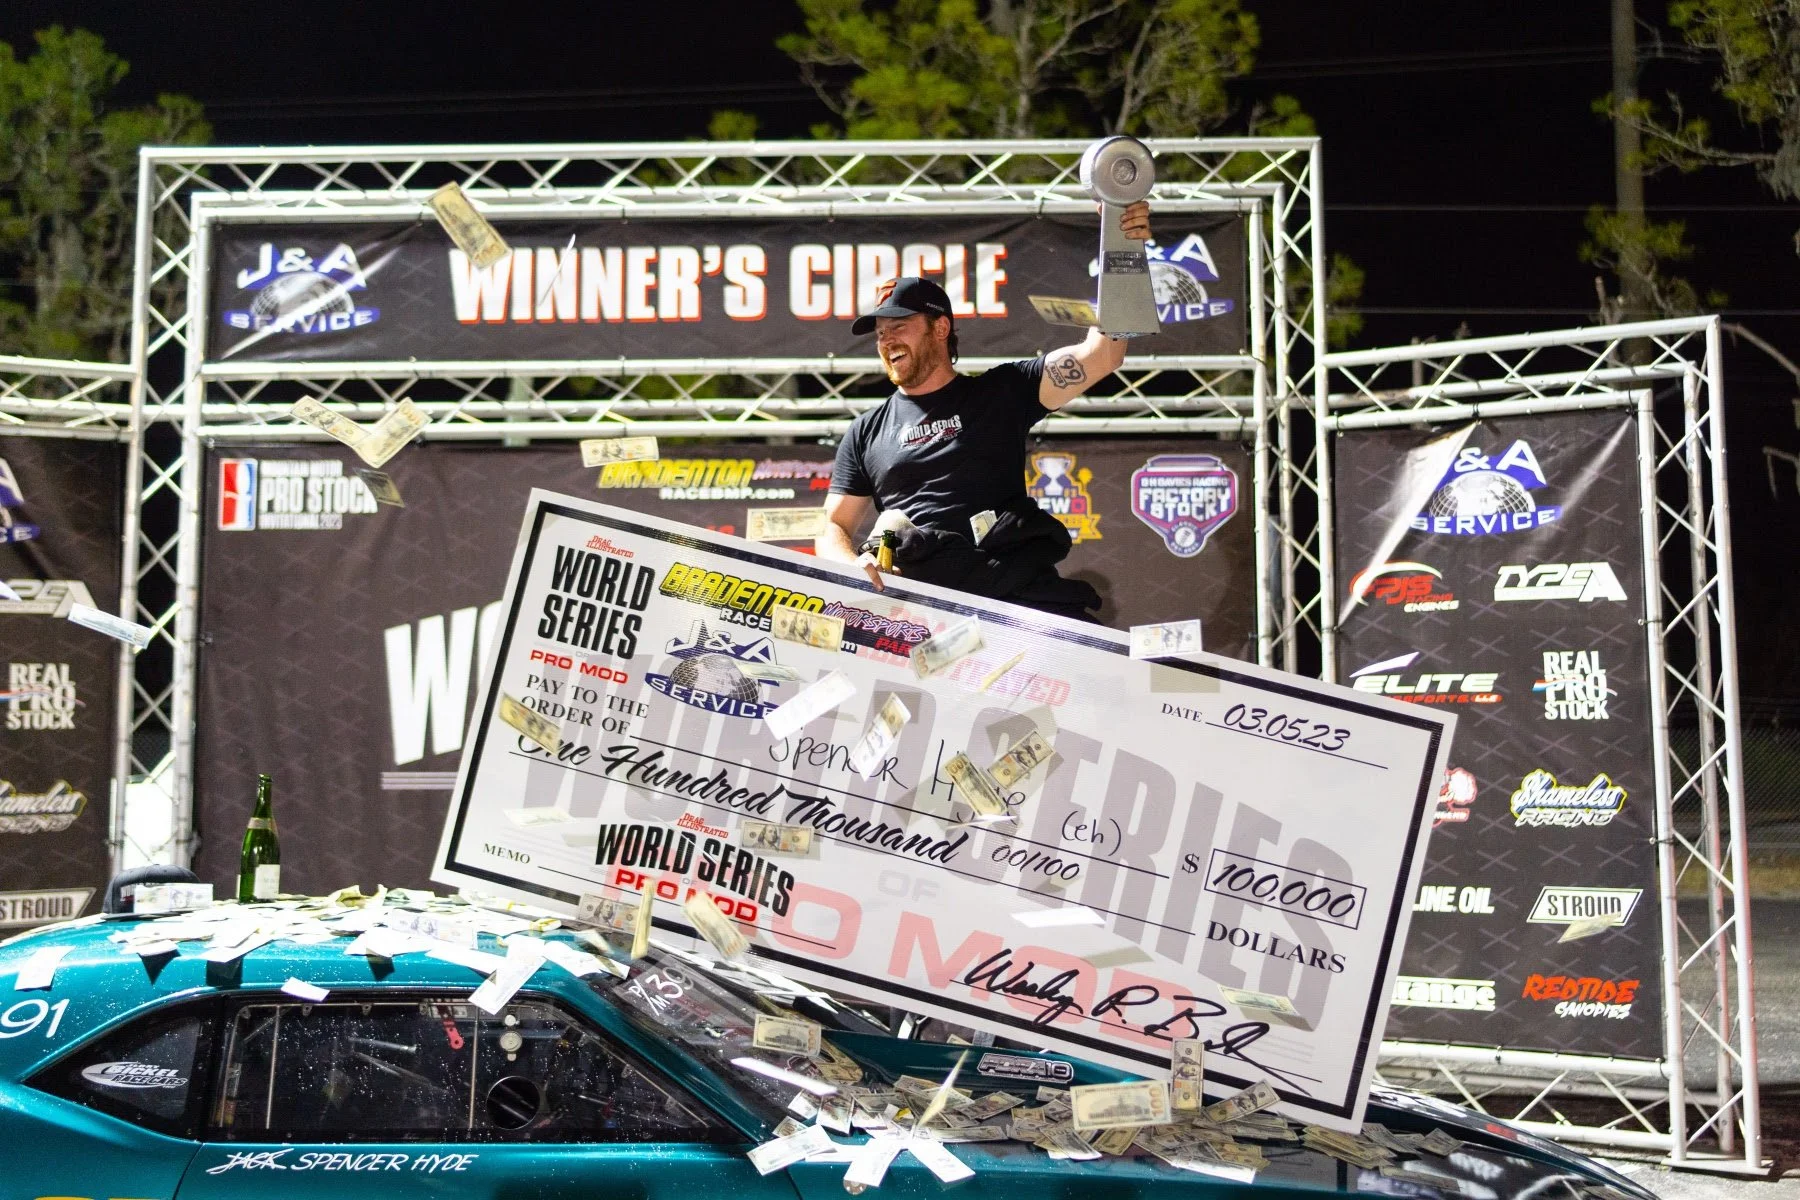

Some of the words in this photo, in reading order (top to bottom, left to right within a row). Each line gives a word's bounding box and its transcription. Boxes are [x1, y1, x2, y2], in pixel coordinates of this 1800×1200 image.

[236, 242, 367, 290] J&A
[448, 245, 767, 324] WINNER'S
[789, 243, 1008, 320] CIRCLE
[259, 476, 304, 514] PRO
[1140, 487, 1231, 512] FACTORY
[1151, 502, 1217, 523] STOCK
[552, 544, 656, 612] WORLD
[538, 593, 643, 660] SERIES
[874, 638, 914, 658] PAR
[1543, 650, 1607, 675] REAL
[9, 663, 75, 686] REAL
[530, 649, 572, 670] PRO
[579, 662, 629, 684] MOD
[526, 674, 564, 695] PAY
[571, 685, 598, 705] TO
[607, 695, 650, 719] THE
[1353, 673, 1499, 693] ELITE
[1545, 673, 1608, 702] PRO
[7, 710, 76, 730] STOCK
[521, 695, 594, 727] ORDER
[602, 717, 631, 735] OF
[1545, 700, 1609, 720] STOCK
[1161, 702, 1203, 723] DATE
[1223, 703, 1351, 751] 03.05.23
[601, 742, 776, 815] Hundred
[781, 783, 969, 864] Thousand
[483, 842, 531, 865] MEMO
[595, 823, 697, 875] WORLD
[697, 837, 796, 918] SERIES
[1181, 852, 1201, 875] $
[1212, 862, 1356, 918] 100,000
[1459, 886, 1495, 914] OIL
[1207, 919, 1347, 974] DOLLARS
[1522, 972, 1641, 1004] REDTIDE
[102, 1065, 179, 1077] BICKEL
[290, 1152, 410, 1172] SPENCER
[411, 1154, 480, 1174] HYDE
